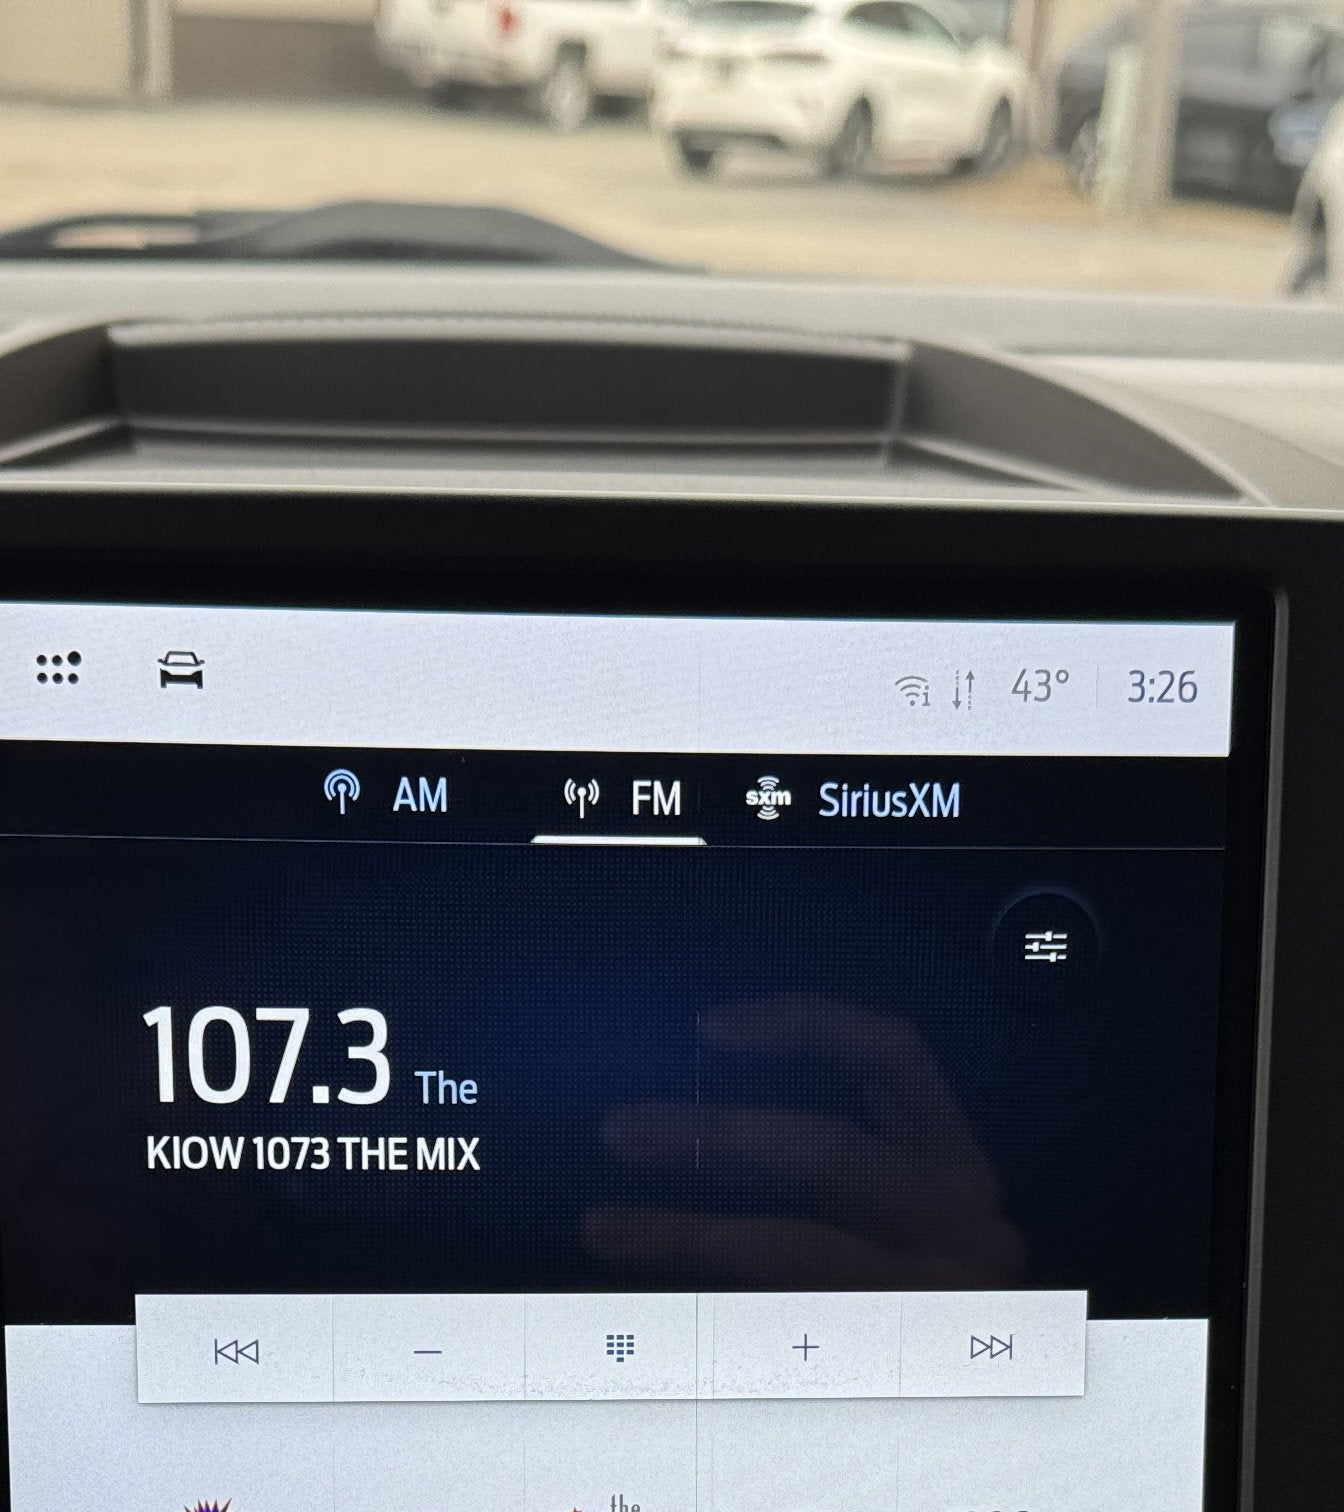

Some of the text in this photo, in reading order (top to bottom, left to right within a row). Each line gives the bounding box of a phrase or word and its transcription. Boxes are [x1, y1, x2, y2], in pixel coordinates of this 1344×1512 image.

[1010, 668, 1070, 703] 43°
[1126, 670, 1198, 704] 3:26
[392, 777, 448, 813] AM
[632, 781, 681, 816] FM
[745, 786, 792, 807] sxm
[818, 783, 961, 819] SiriusXM
[142, 1005, 479, 1106] 107.3 The
[146, 1135, 481, 1171] KIOW 1073 THE MIX
